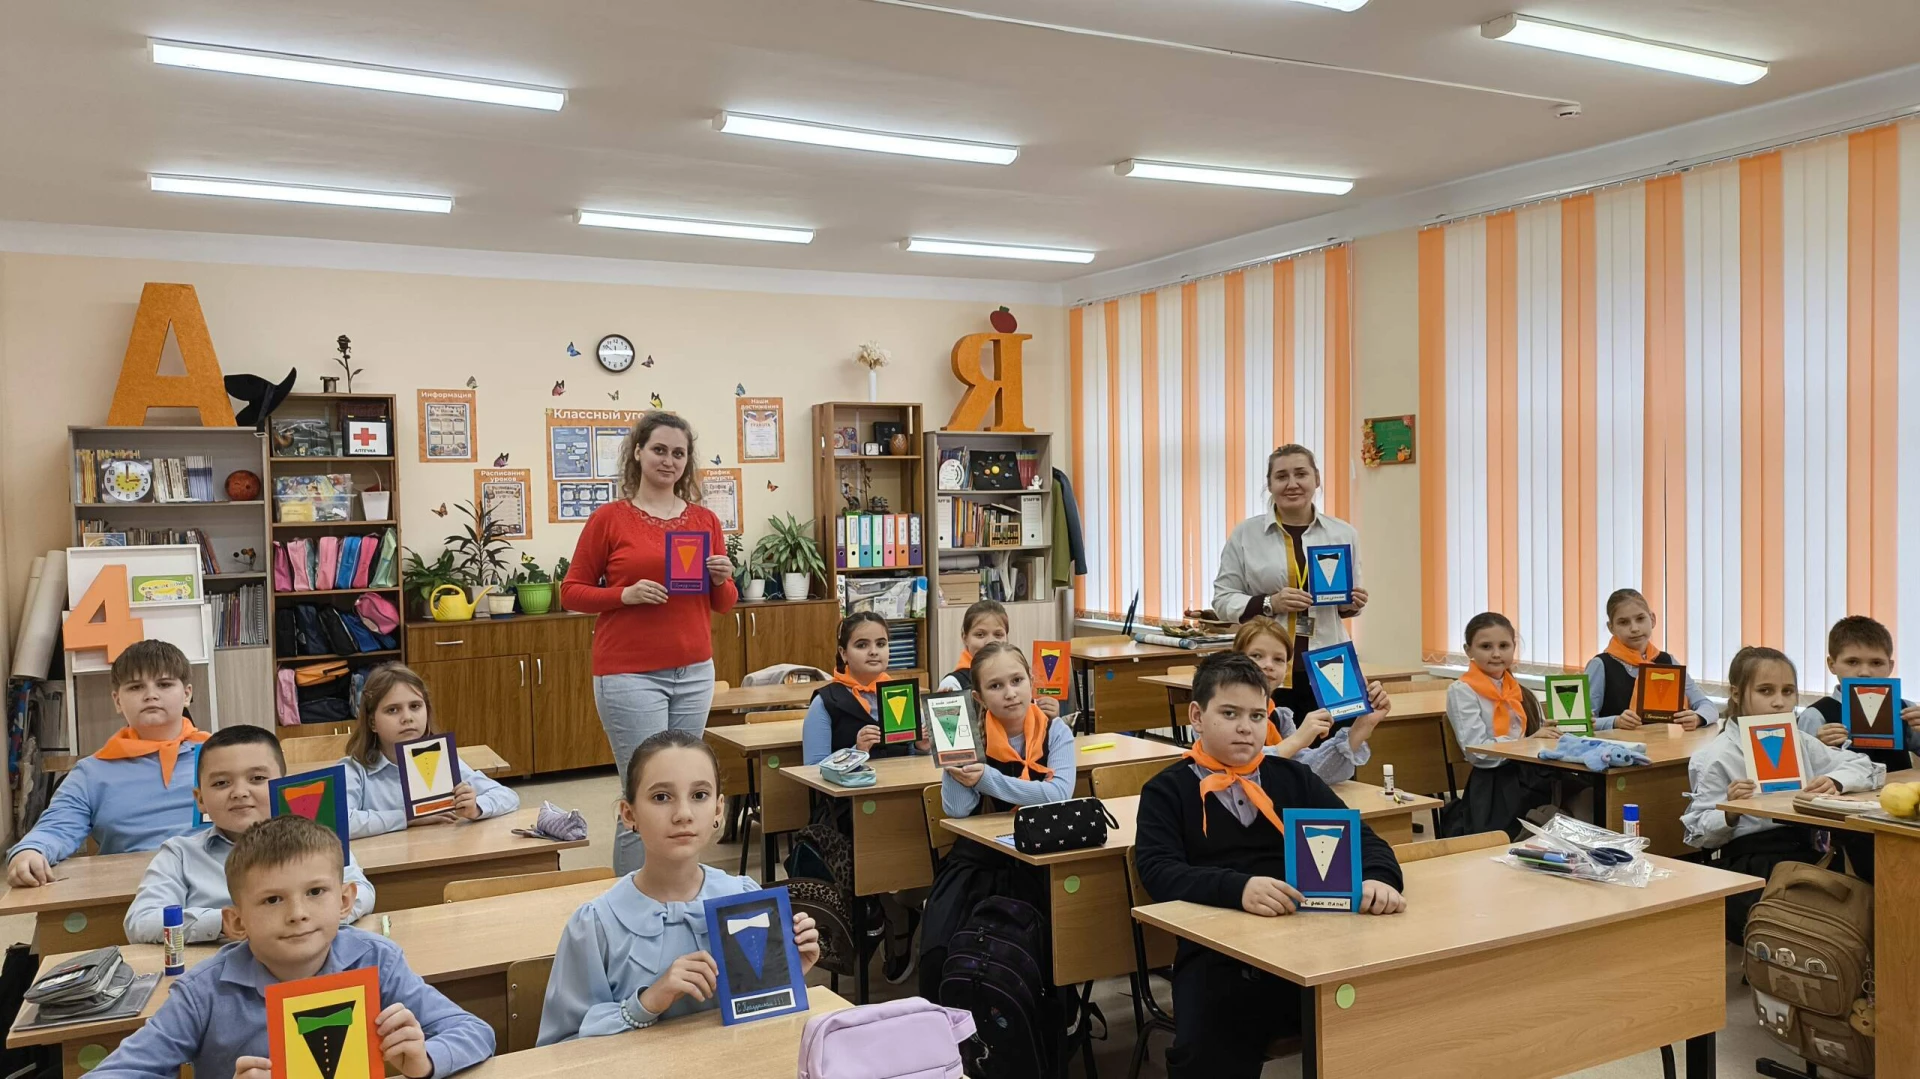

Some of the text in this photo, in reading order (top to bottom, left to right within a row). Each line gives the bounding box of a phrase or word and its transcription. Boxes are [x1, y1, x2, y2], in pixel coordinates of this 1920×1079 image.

[108, 282, 236, 427] А
[421, 391, 472, 399] Информация
[940, 332, 1035, 433] Я
[553, 408, 646, 423] Классный уго
[63, 564, 143, 664] 4
